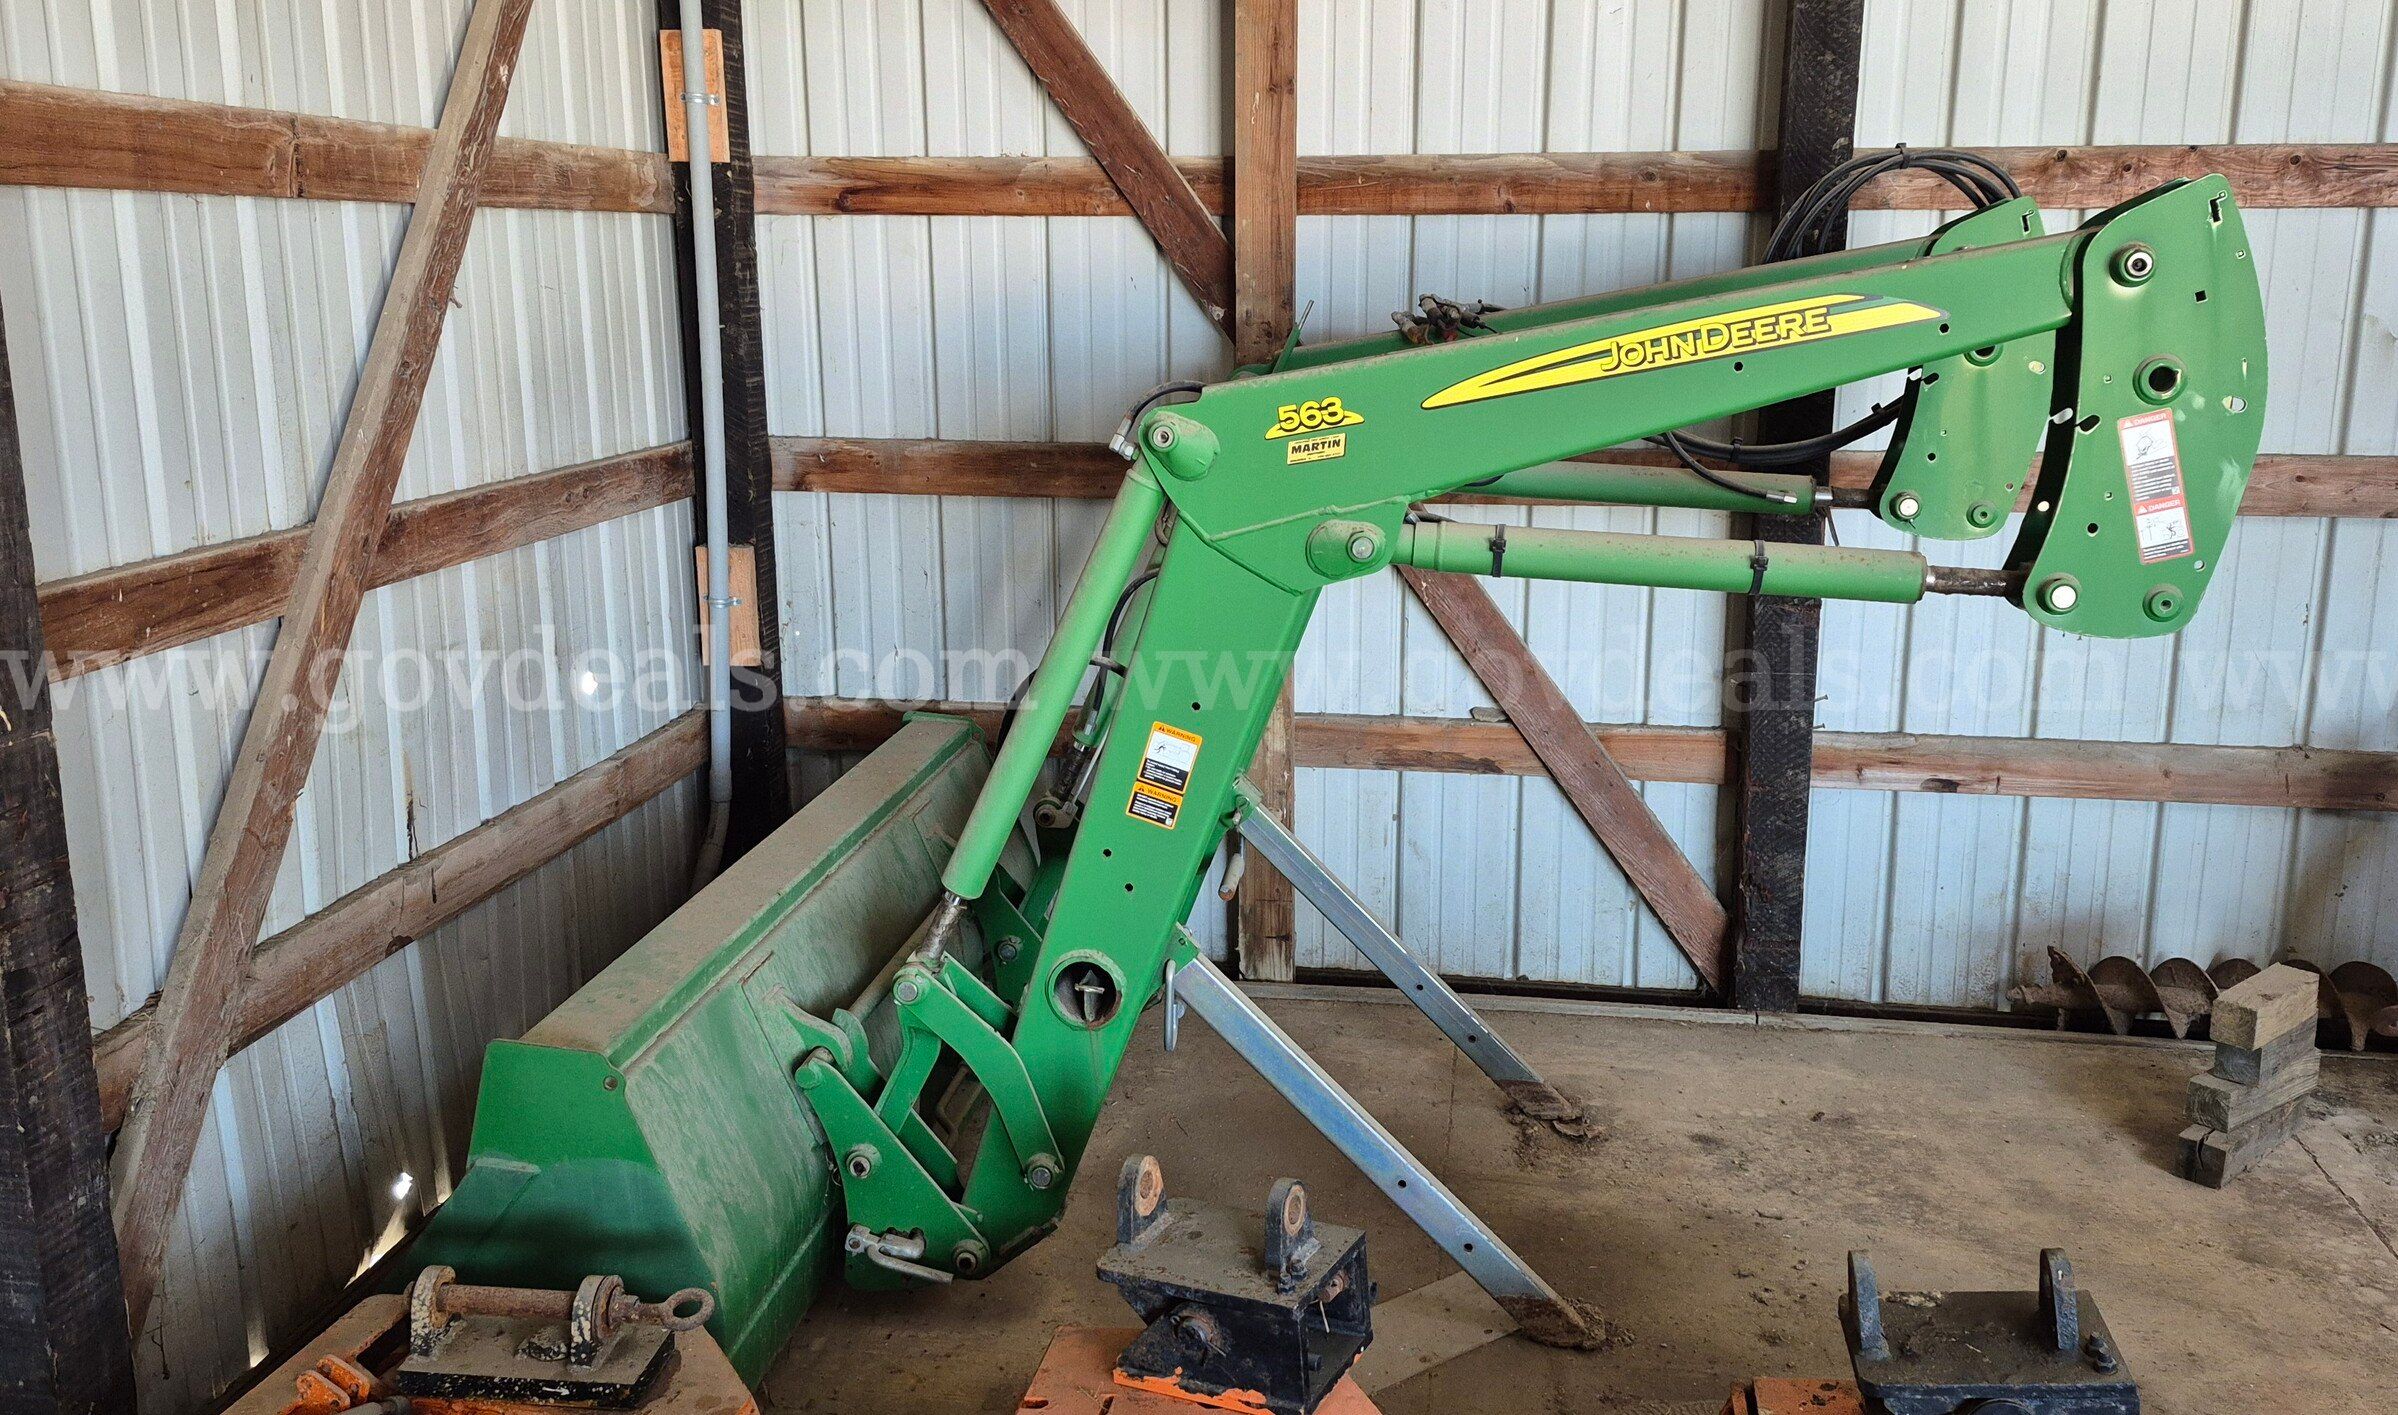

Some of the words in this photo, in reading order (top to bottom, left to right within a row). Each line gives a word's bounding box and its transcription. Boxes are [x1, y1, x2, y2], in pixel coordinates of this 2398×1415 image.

[1601, 322, 1698, 371] JOHN
[1700, 307, 1832, 354] DEERE
[1278, 396, 1345, 432] 563
[2134, 412, 2167, 426] DANGER
[1291, 439, 1341, 454] MARTIN
[2147, 499, 2181, 512] DANGER
[1166, 728, 1196, 743] WARNING
[1147, 788, 1177, 803] WARNING
